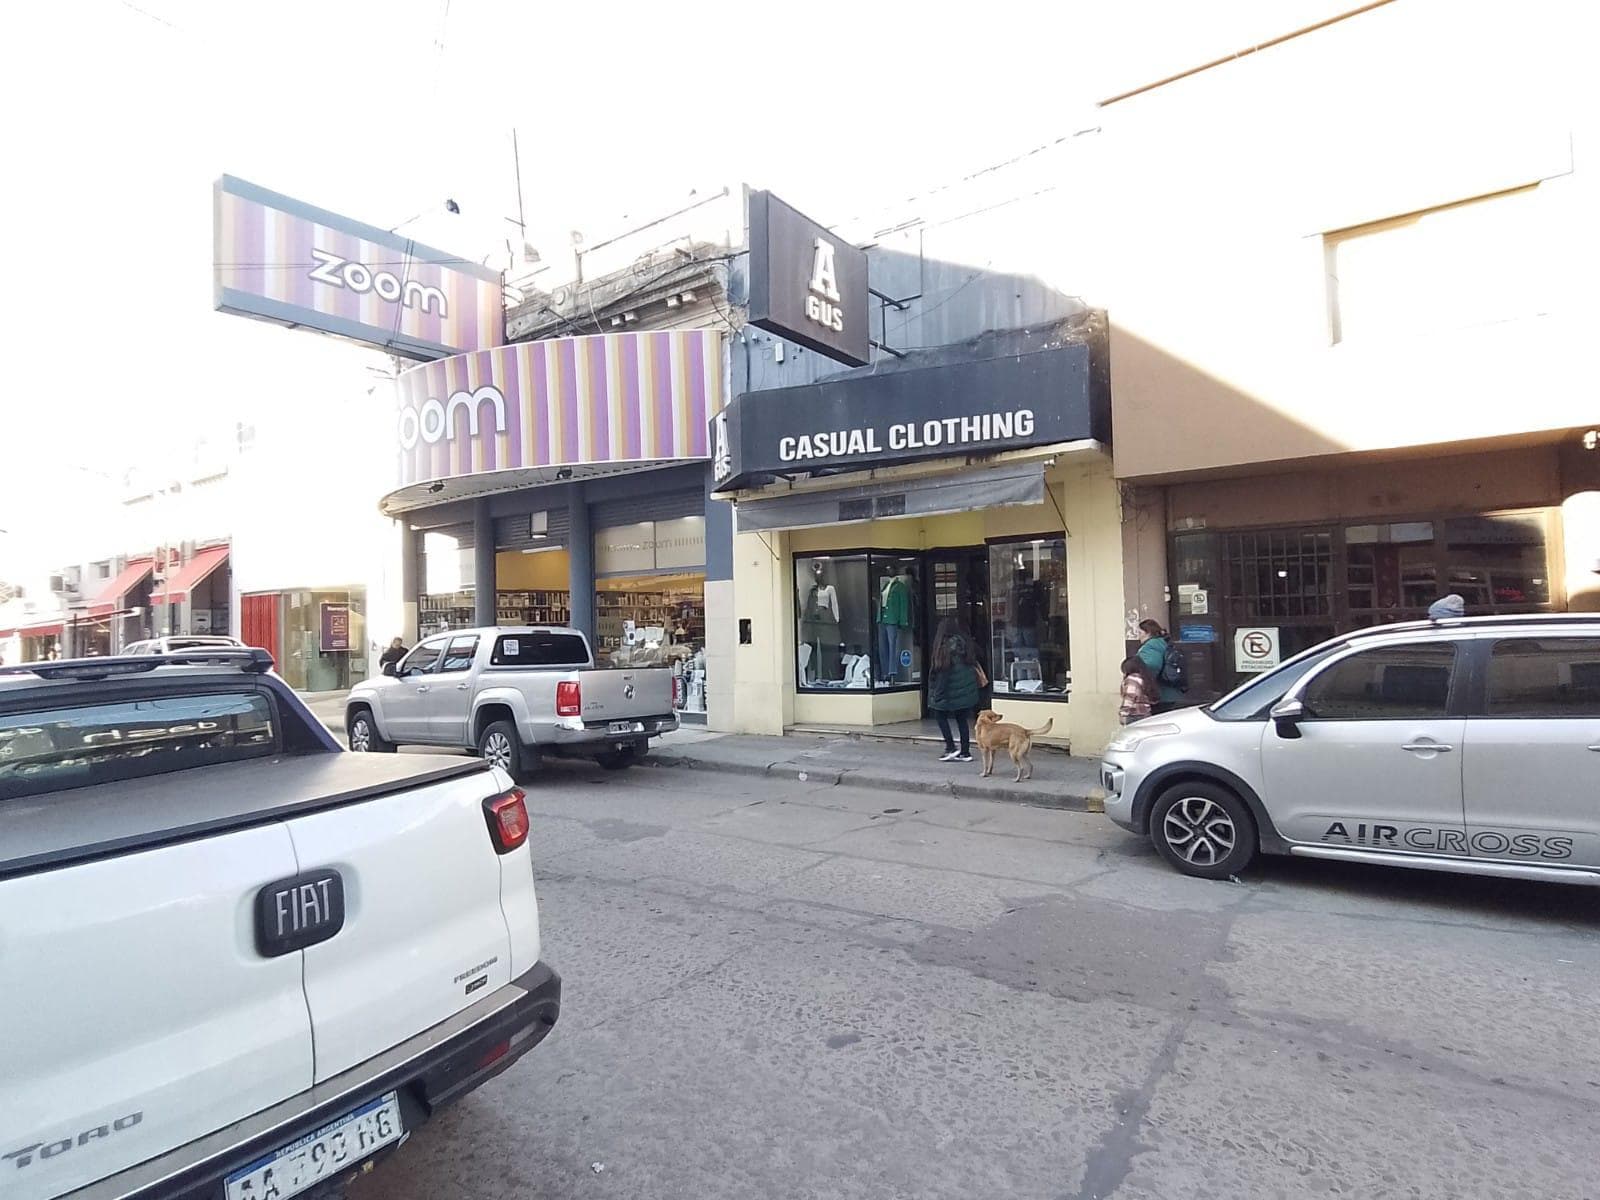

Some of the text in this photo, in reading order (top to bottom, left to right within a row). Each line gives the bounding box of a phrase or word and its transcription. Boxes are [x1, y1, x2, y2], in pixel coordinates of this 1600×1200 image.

[308, 248, 448, 319] zoom
[808, 236, 841, 302] A
[806, 295, 843, 332] GUS
[400, 385, 506, 451] oom
[779, 409, 1034, 461] CASUAL CLOTHING
[1321, 822, 1573, 859] AIRCROSS
[275, 878, 333, 936] FIAT
[1, 1111, 144, 1169] TORO
